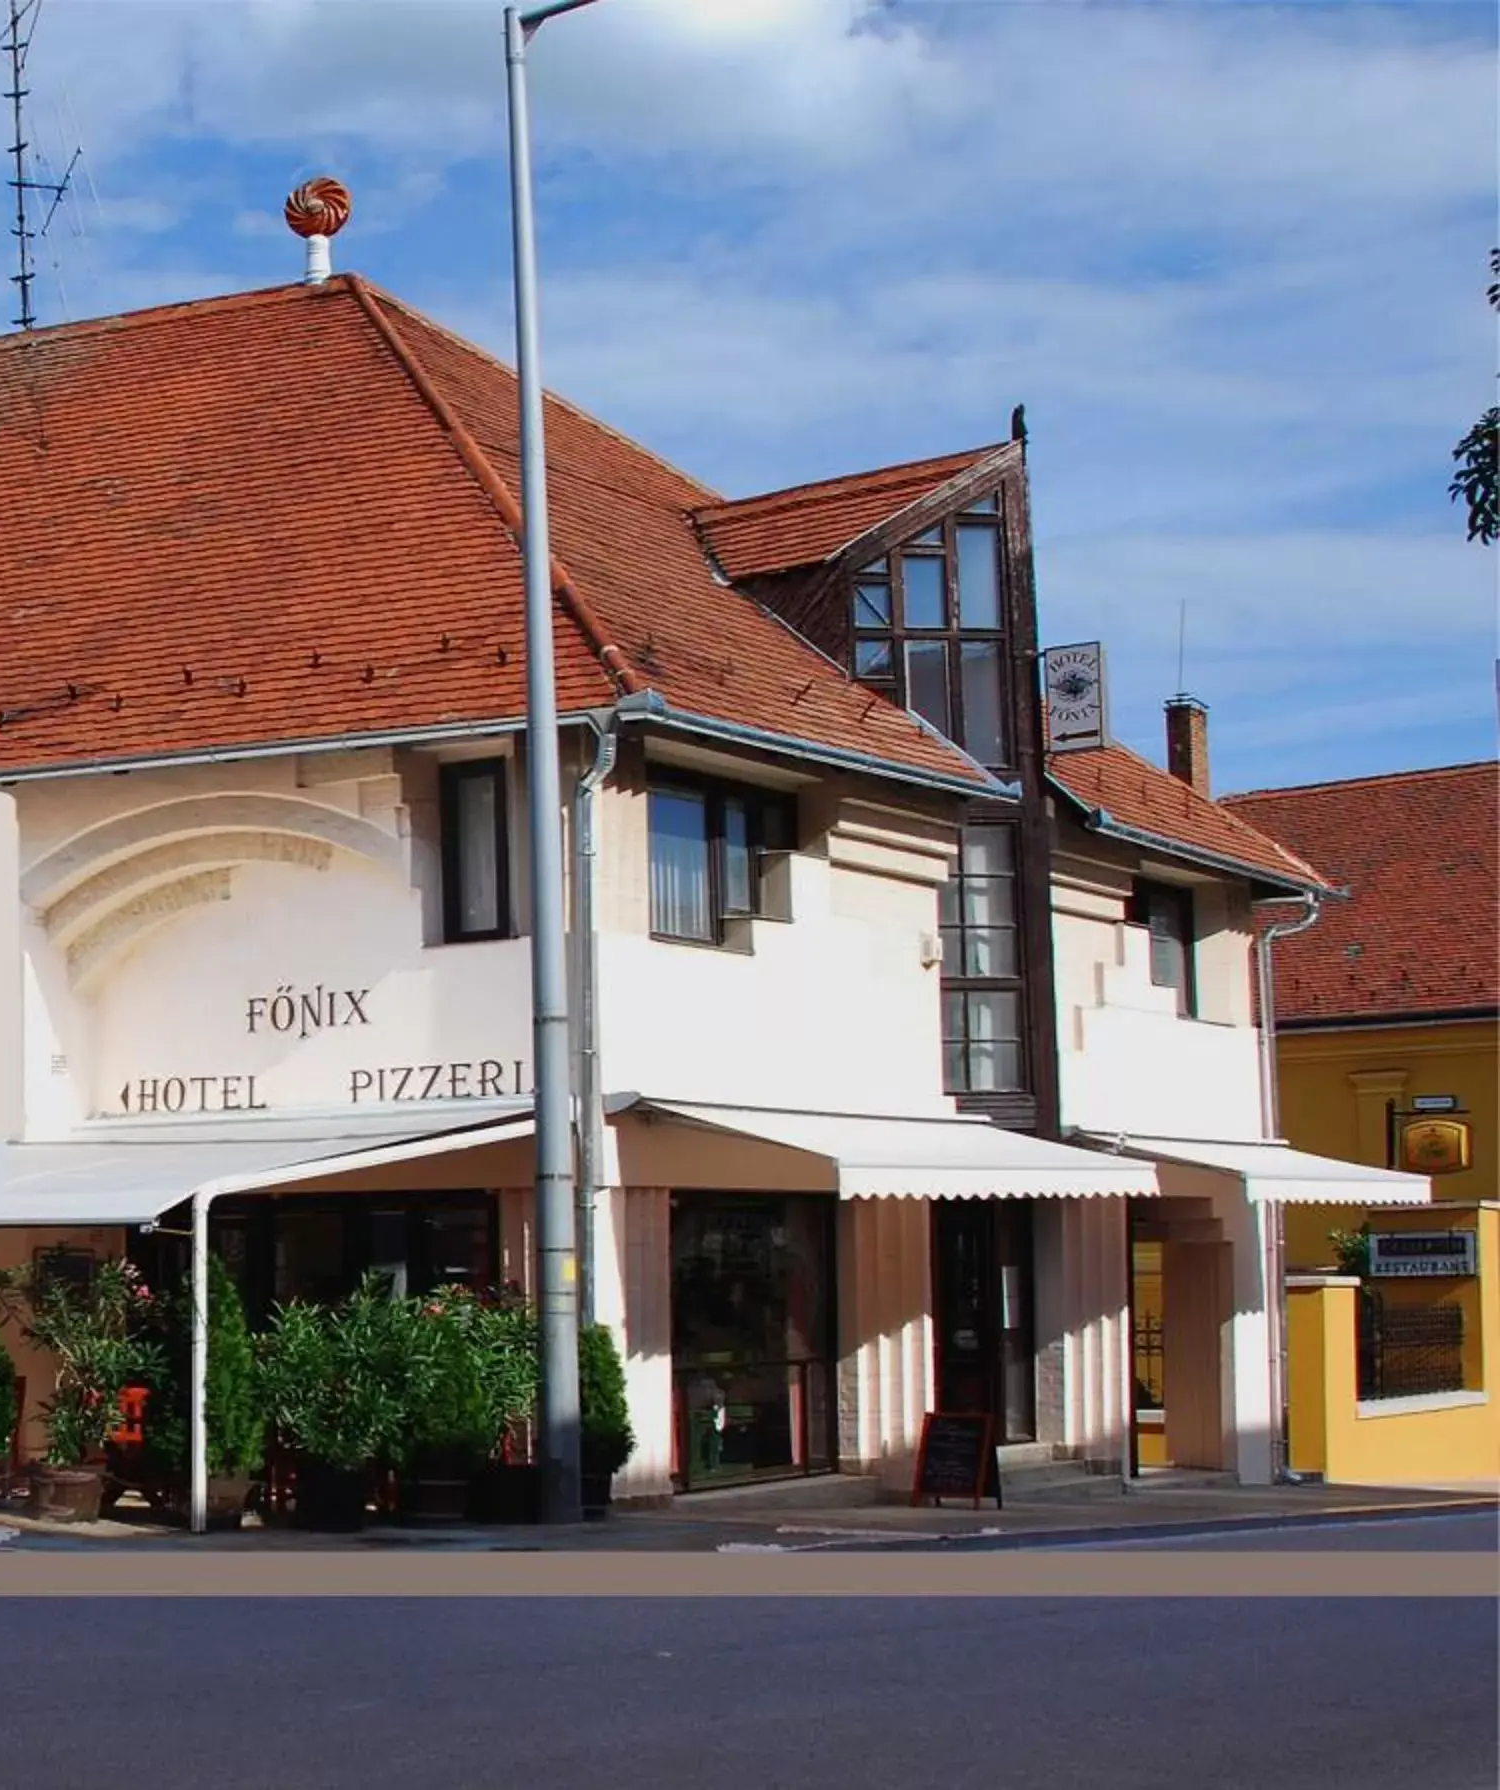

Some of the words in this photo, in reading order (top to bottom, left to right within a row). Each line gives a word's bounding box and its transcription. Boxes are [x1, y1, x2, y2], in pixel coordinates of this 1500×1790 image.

[245, 984, 372, 1038] FŐNIX
[137, 1075, 268, 1113] HOTEL
[349, 1058, 537, 1104] PIZZERI
